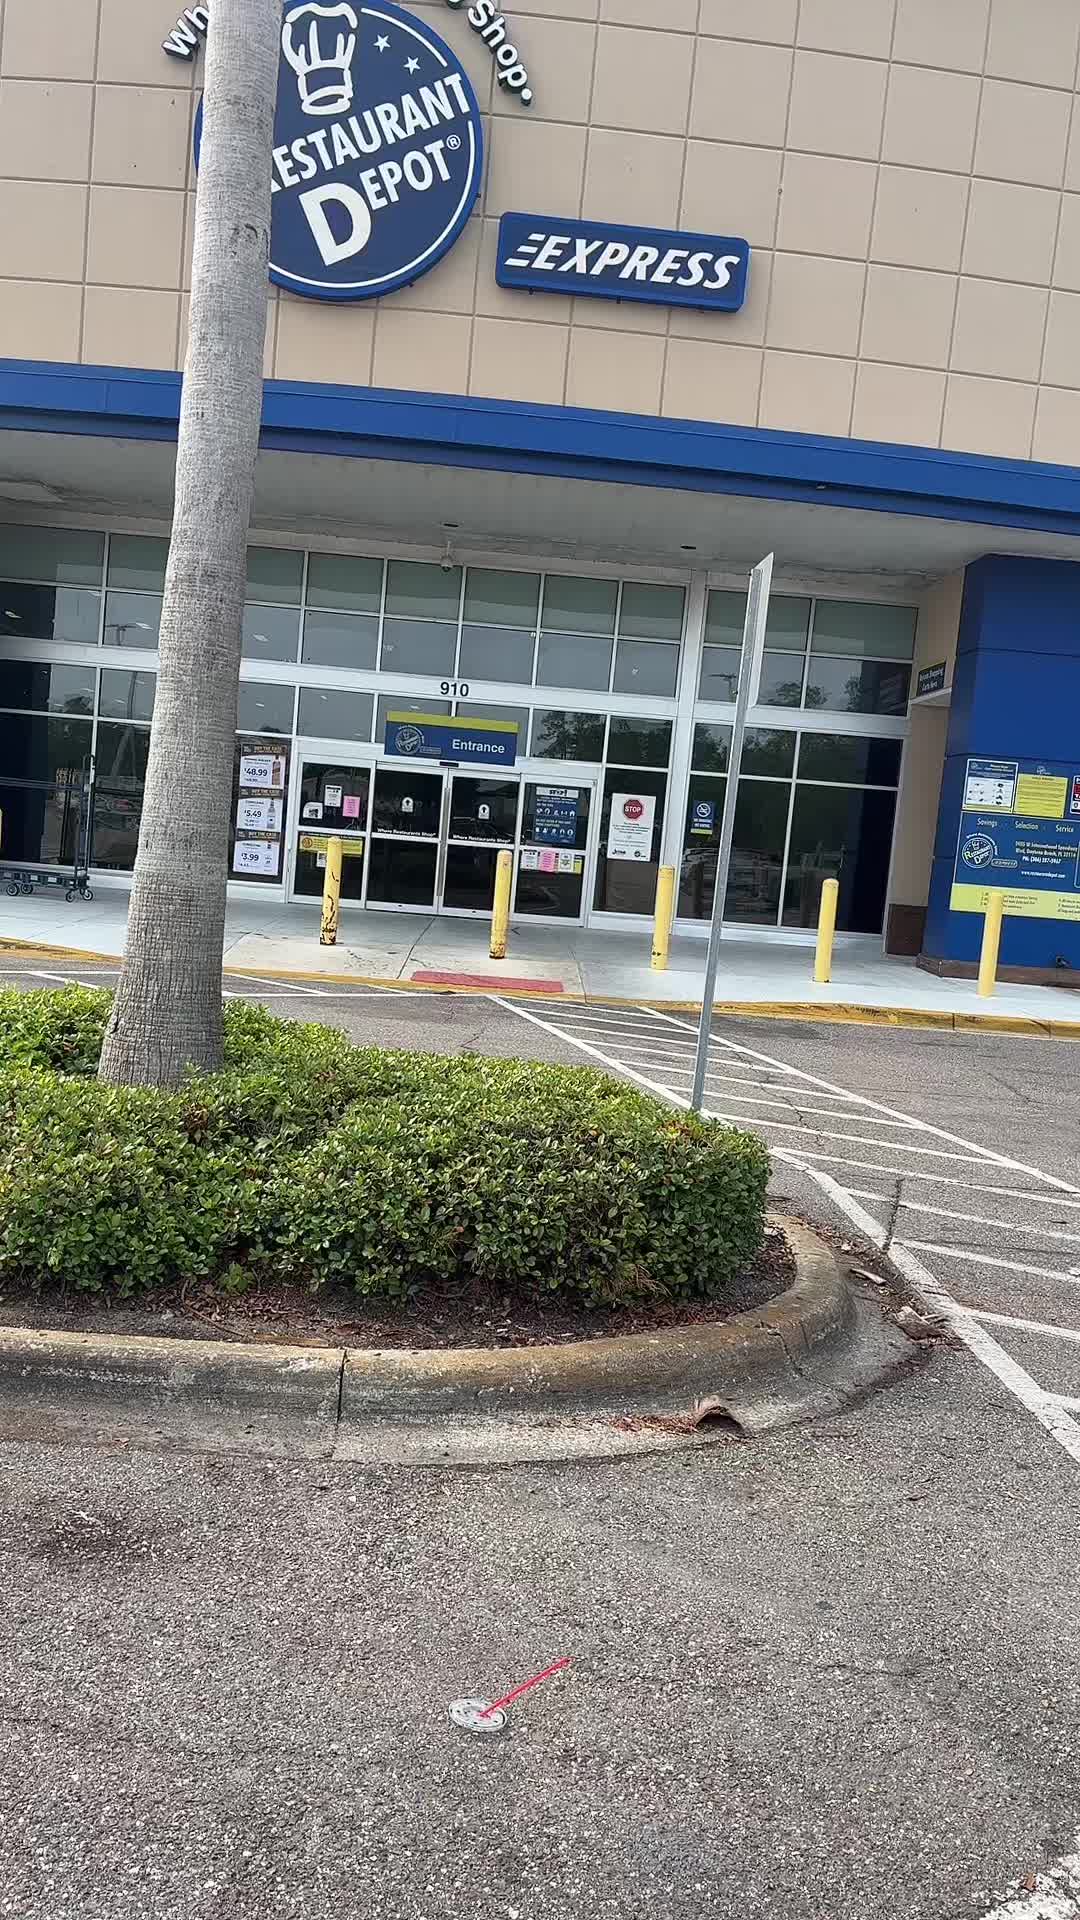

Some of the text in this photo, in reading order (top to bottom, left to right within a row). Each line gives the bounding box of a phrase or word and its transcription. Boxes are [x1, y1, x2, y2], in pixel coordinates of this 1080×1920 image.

[468, 0, 532, 100] Shop.
[271, 72, 471, 193] ESTAURANT
[505, 232, 741, 290] EXPRESS
[440, 681, 469, 697] 910
[452, 738, 505, 754] Entrance
[624, 805, 641, 813] STOP
[1015, 820, 1039, 830] Selection
[1055, 824, 1074, 832] Service
